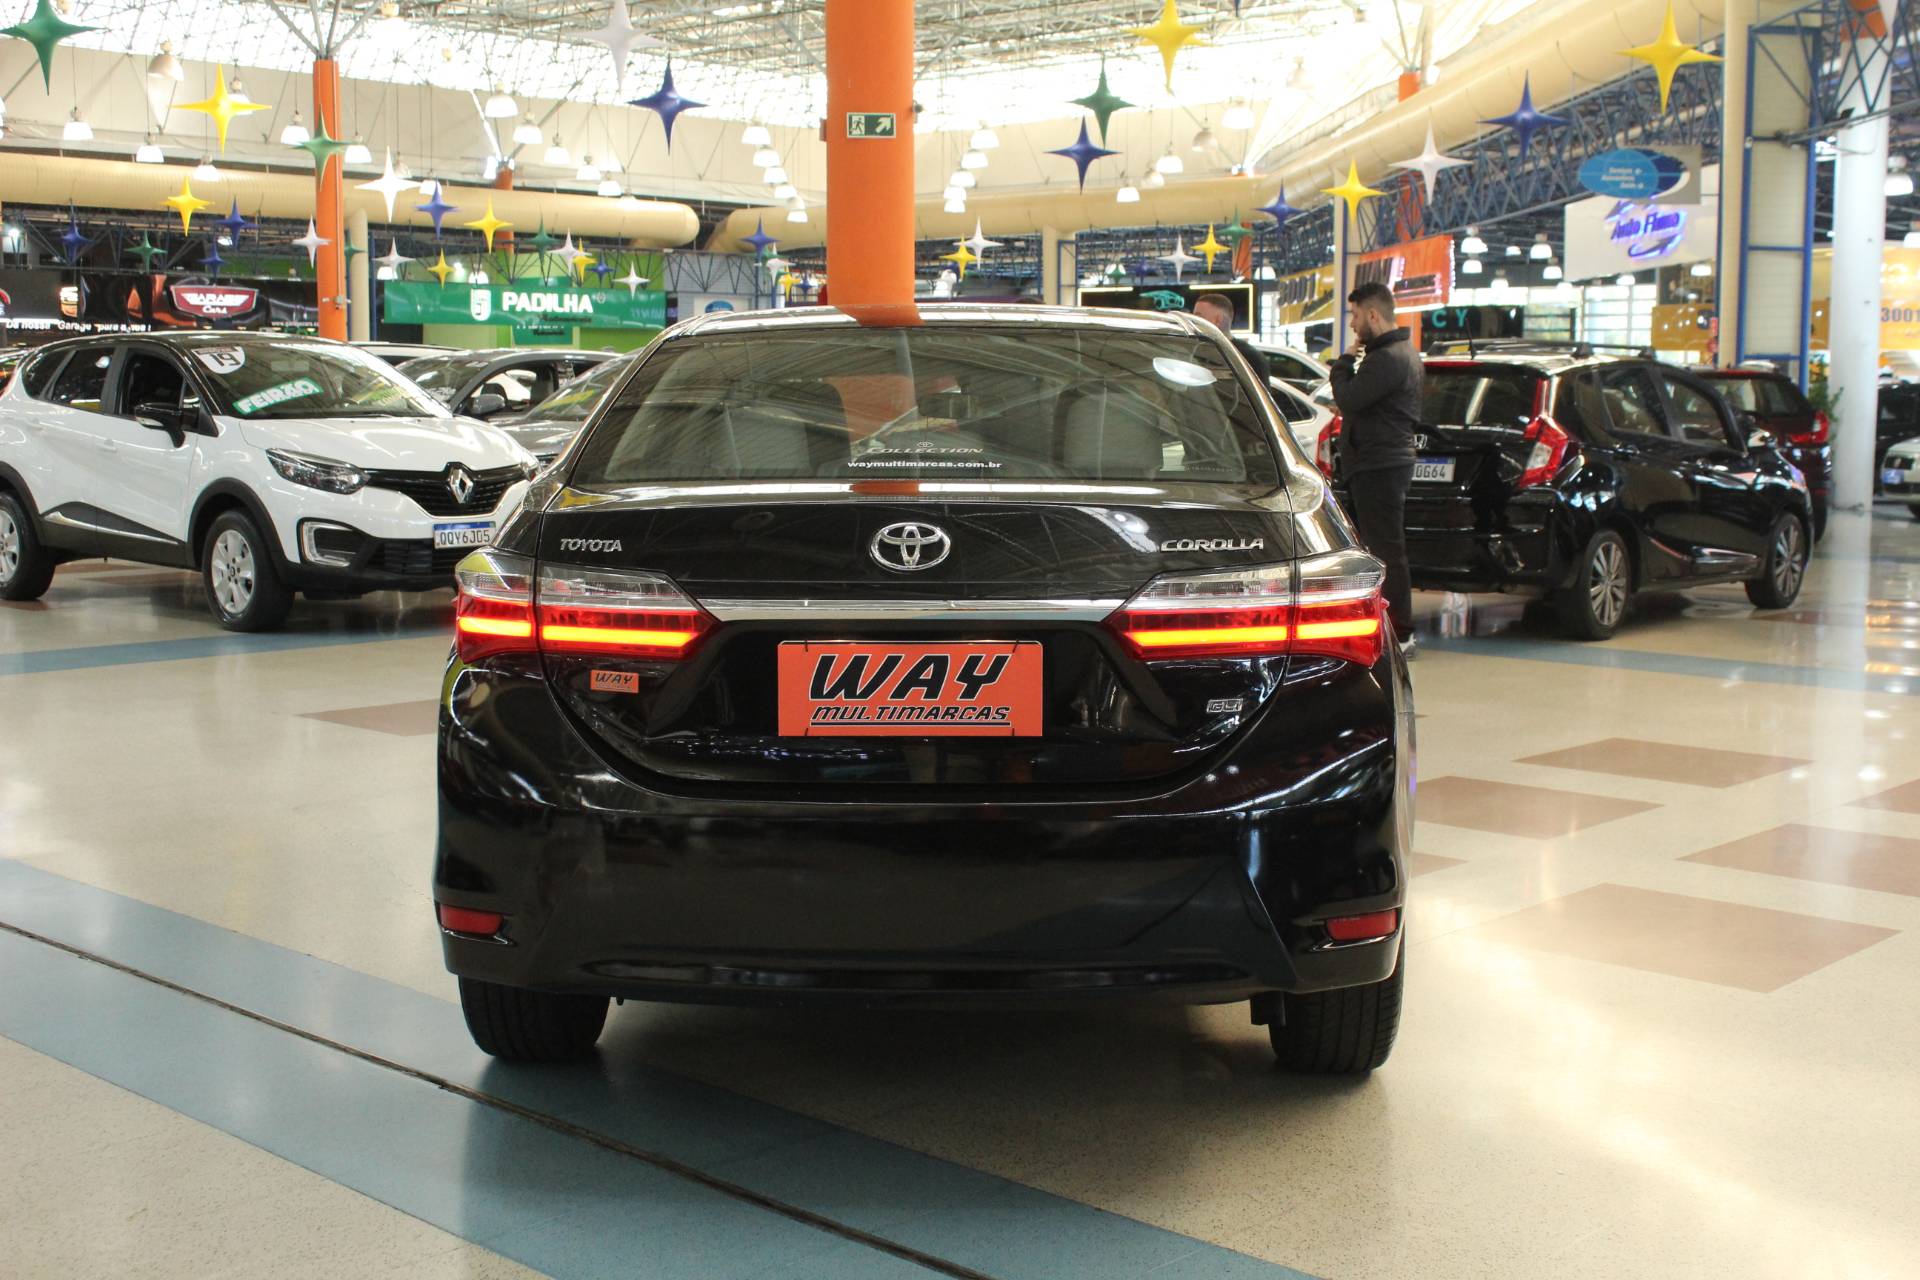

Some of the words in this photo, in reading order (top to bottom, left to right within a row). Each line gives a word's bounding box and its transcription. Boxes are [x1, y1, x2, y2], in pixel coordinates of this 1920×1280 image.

[502, 291, 594, 313] PADILHA
[237, 379, 320, 413] FEIRÃO
[847, 460, 1002, 468] waymultimarcas.com.br
[560, 538, 622, 552] TOYOTA
[1161, 538, 1264, 552] COROLLA
[595, 672, 633, 684] WAY
[808, 654, 1012, 701] WAY
[811, 705, 1011, 721] MULTIMARCAS
